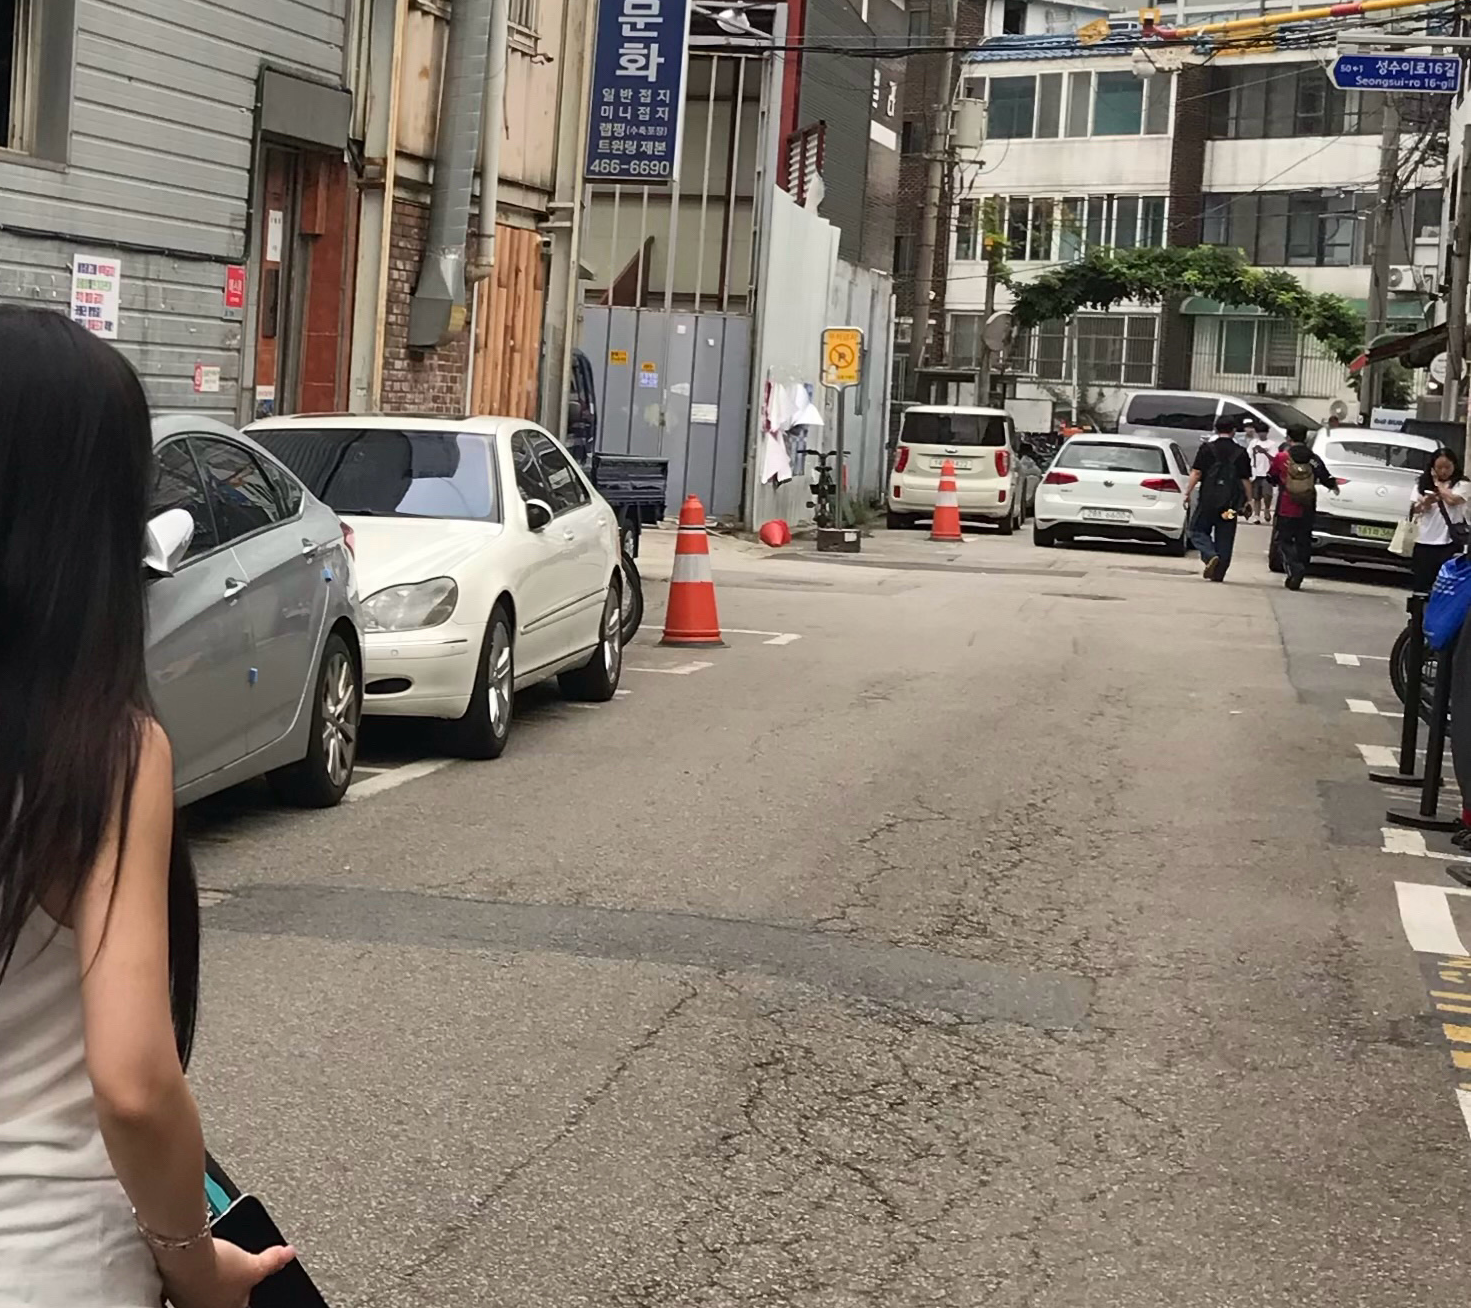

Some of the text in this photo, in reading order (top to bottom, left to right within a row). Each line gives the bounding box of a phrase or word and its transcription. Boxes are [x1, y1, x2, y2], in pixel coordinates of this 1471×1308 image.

[1375, 59, 1456, 78] 성수이로16길
[1355, 75, 1455, 90] Seongsui-ro 16-gil
[589, 158, 670, 175] 466-6690
